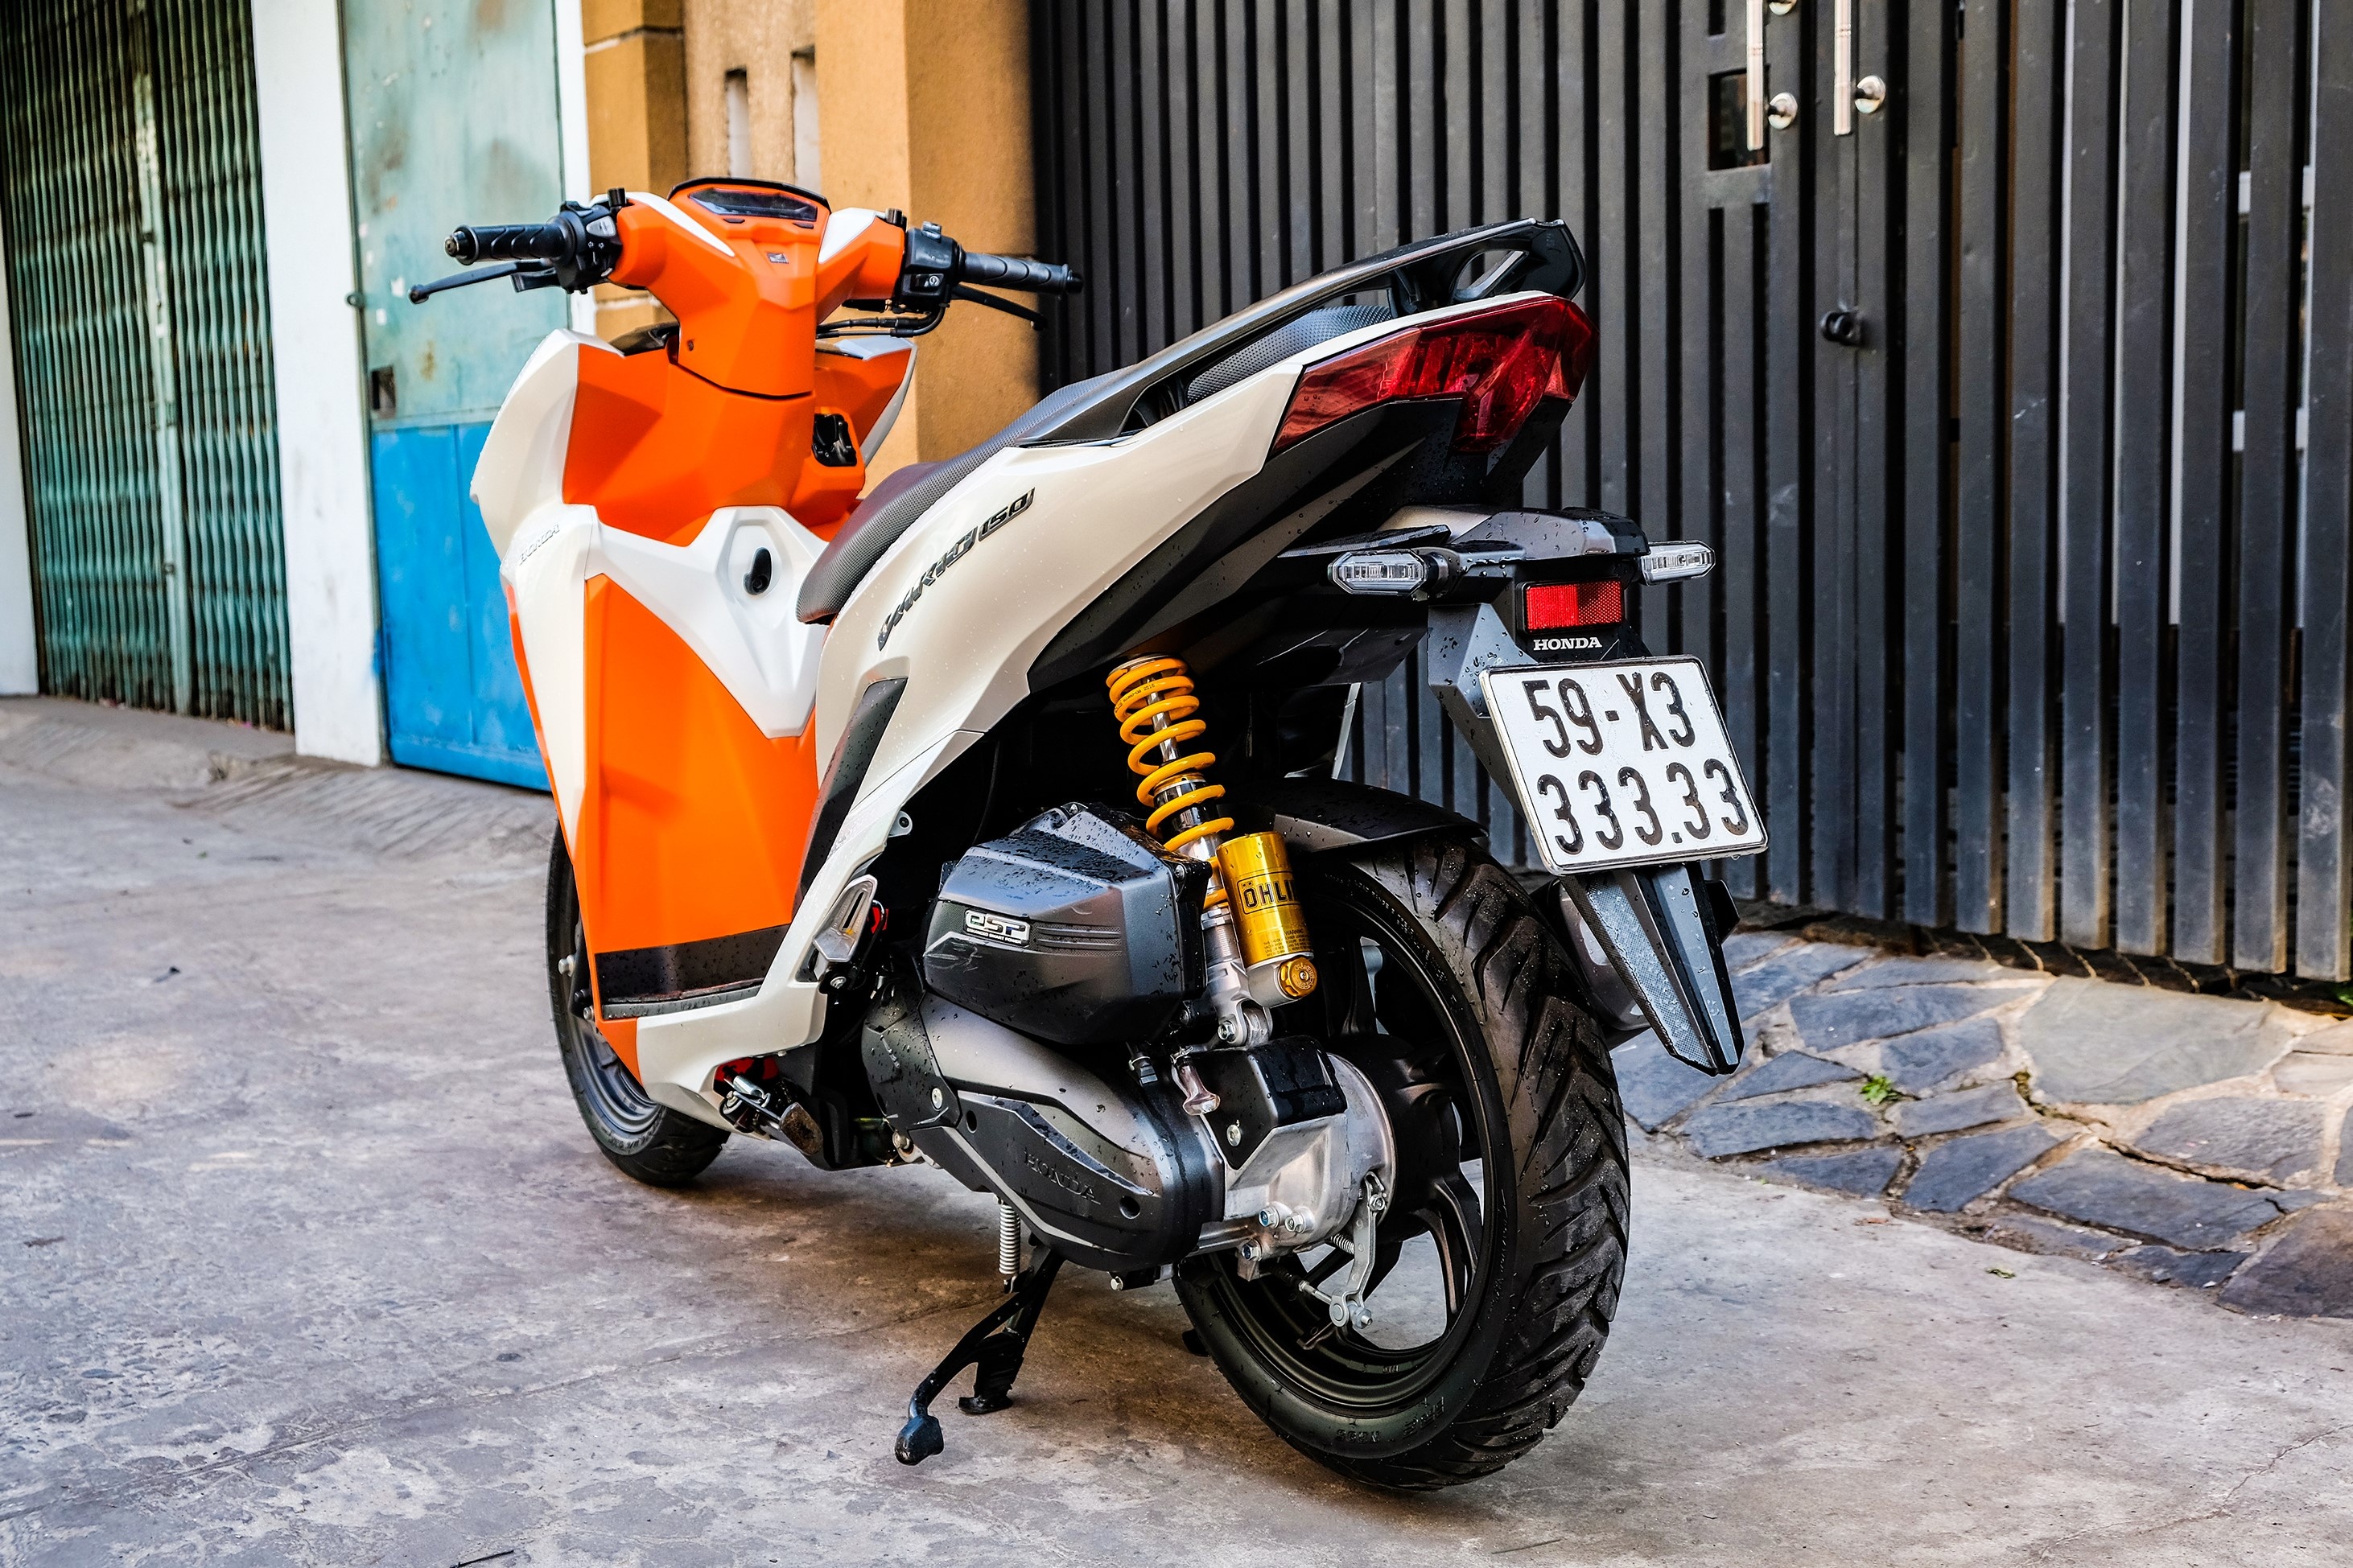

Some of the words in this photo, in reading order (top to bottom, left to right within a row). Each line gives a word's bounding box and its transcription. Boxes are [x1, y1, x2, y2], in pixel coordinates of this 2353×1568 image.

[979, 488, 1034, 541] 150
[1532, 636, 1603, 651] HONDA
[1522, 671, 1696, 758] 59-X3
[1537, 758, 1749, 855] 333.33
[1024, 1146, 1102, 1205] HONDA
